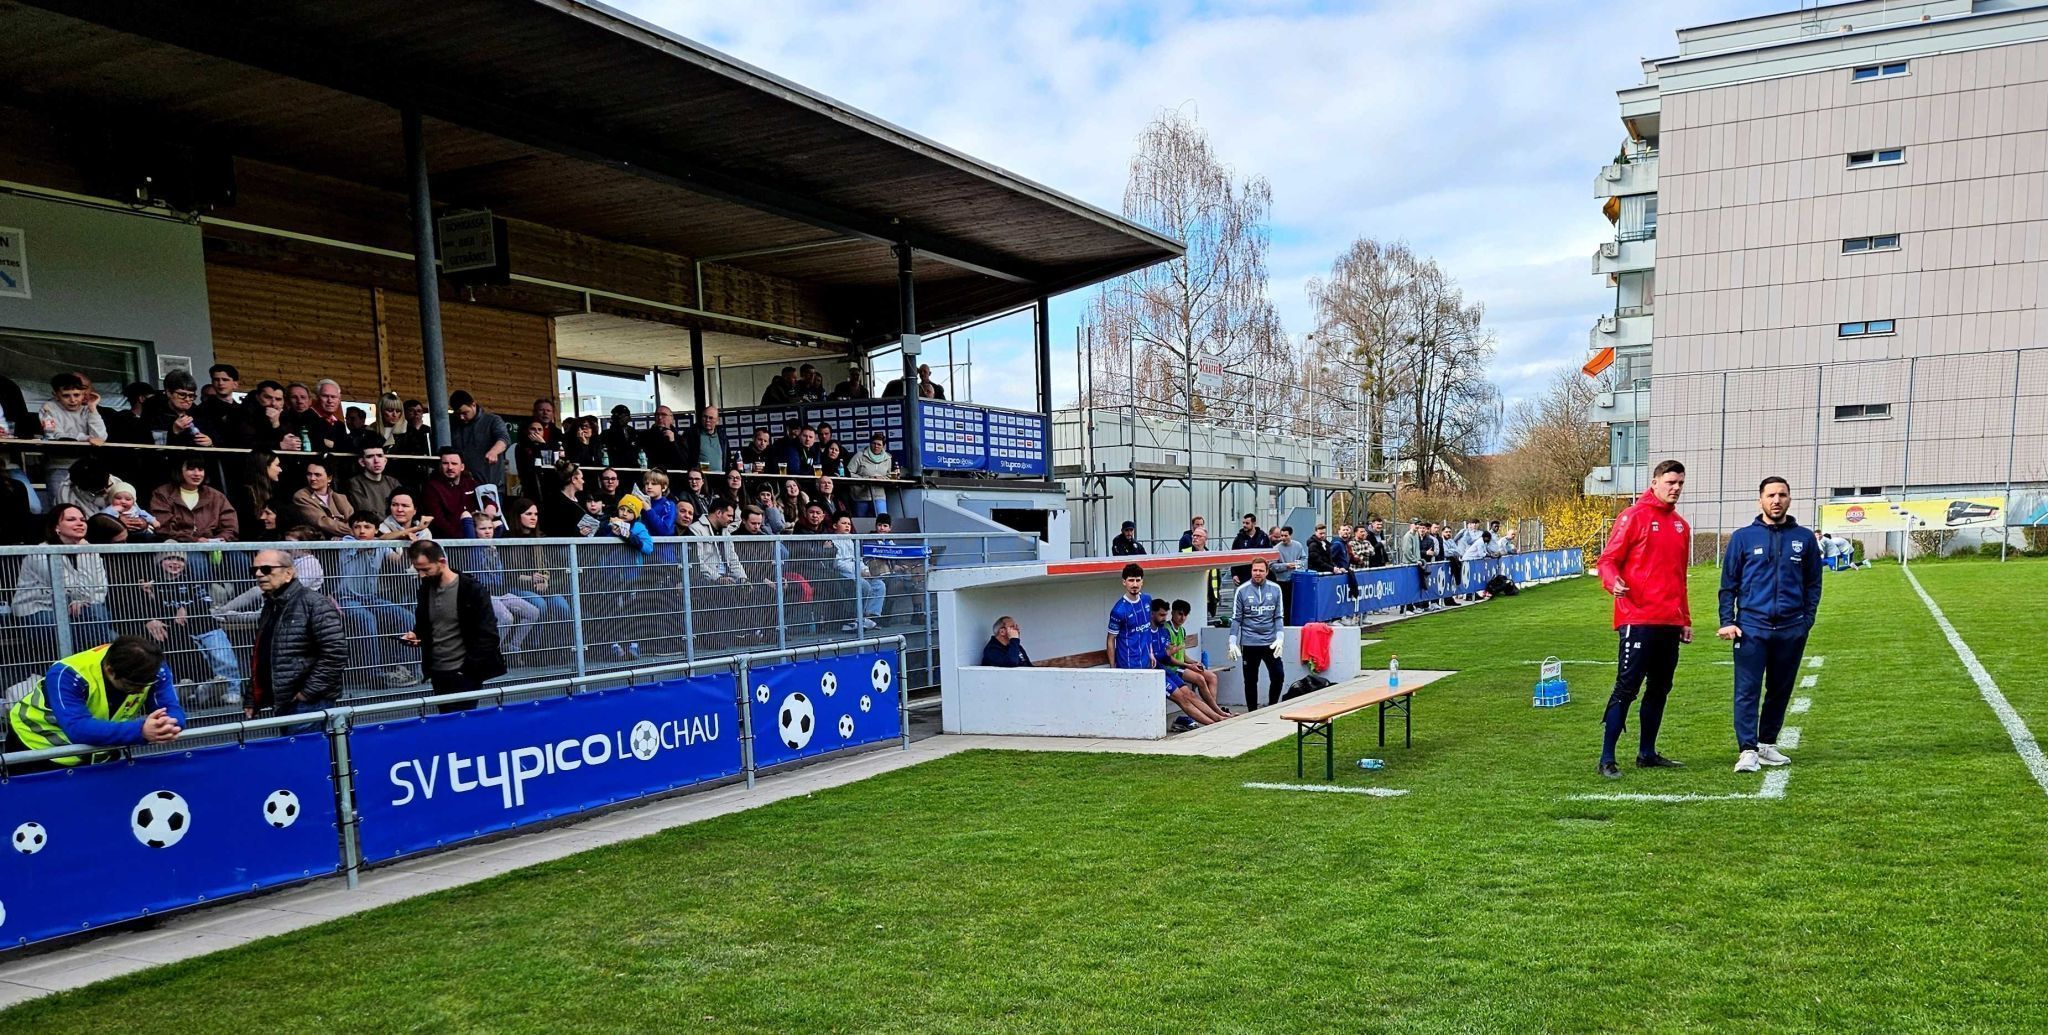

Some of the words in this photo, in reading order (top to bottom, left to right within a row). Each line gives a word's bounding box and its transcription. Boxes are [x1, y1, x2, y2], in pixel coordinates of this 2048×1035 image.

[1336, 584, 1345, 604] SV
[1251, 605, 1275, 615] typico
[389, 755, 439, 806] SV
[448, 733, 612, 809] typico
[617, 713, 720, 761] LOCHAU
